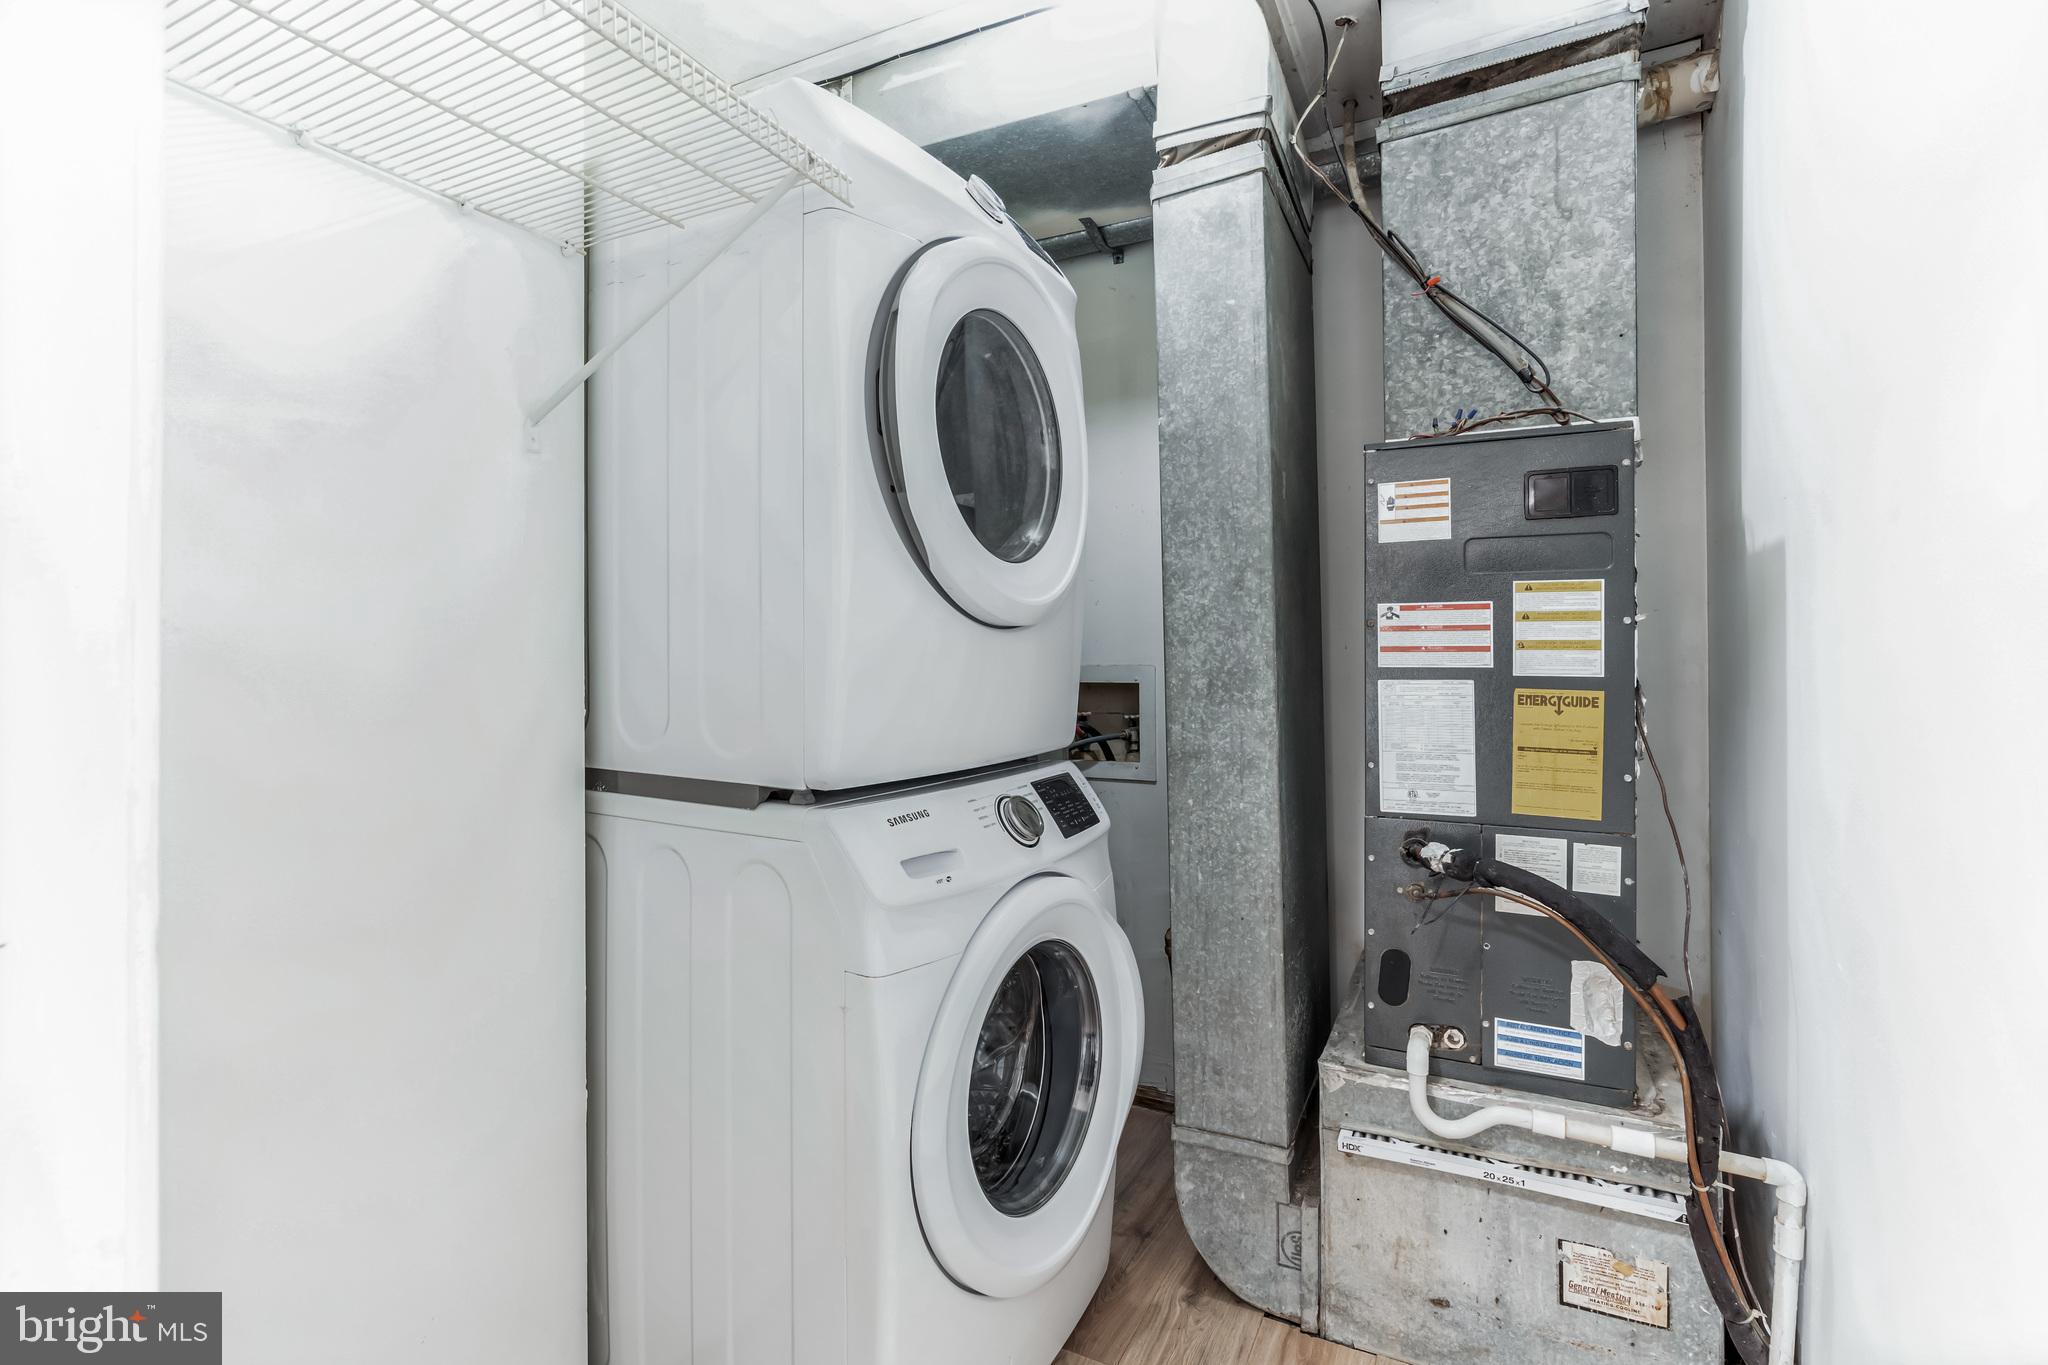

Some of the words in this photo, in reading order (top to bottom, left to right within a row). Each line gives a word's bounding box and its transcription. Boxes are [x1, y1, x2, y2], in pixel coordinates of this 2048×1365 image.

[886, 808, 930, 827] SAMSUNG
[1341, 1141, 1361, 1152] HDX
[1568, 1280, 1598, 1294] General
